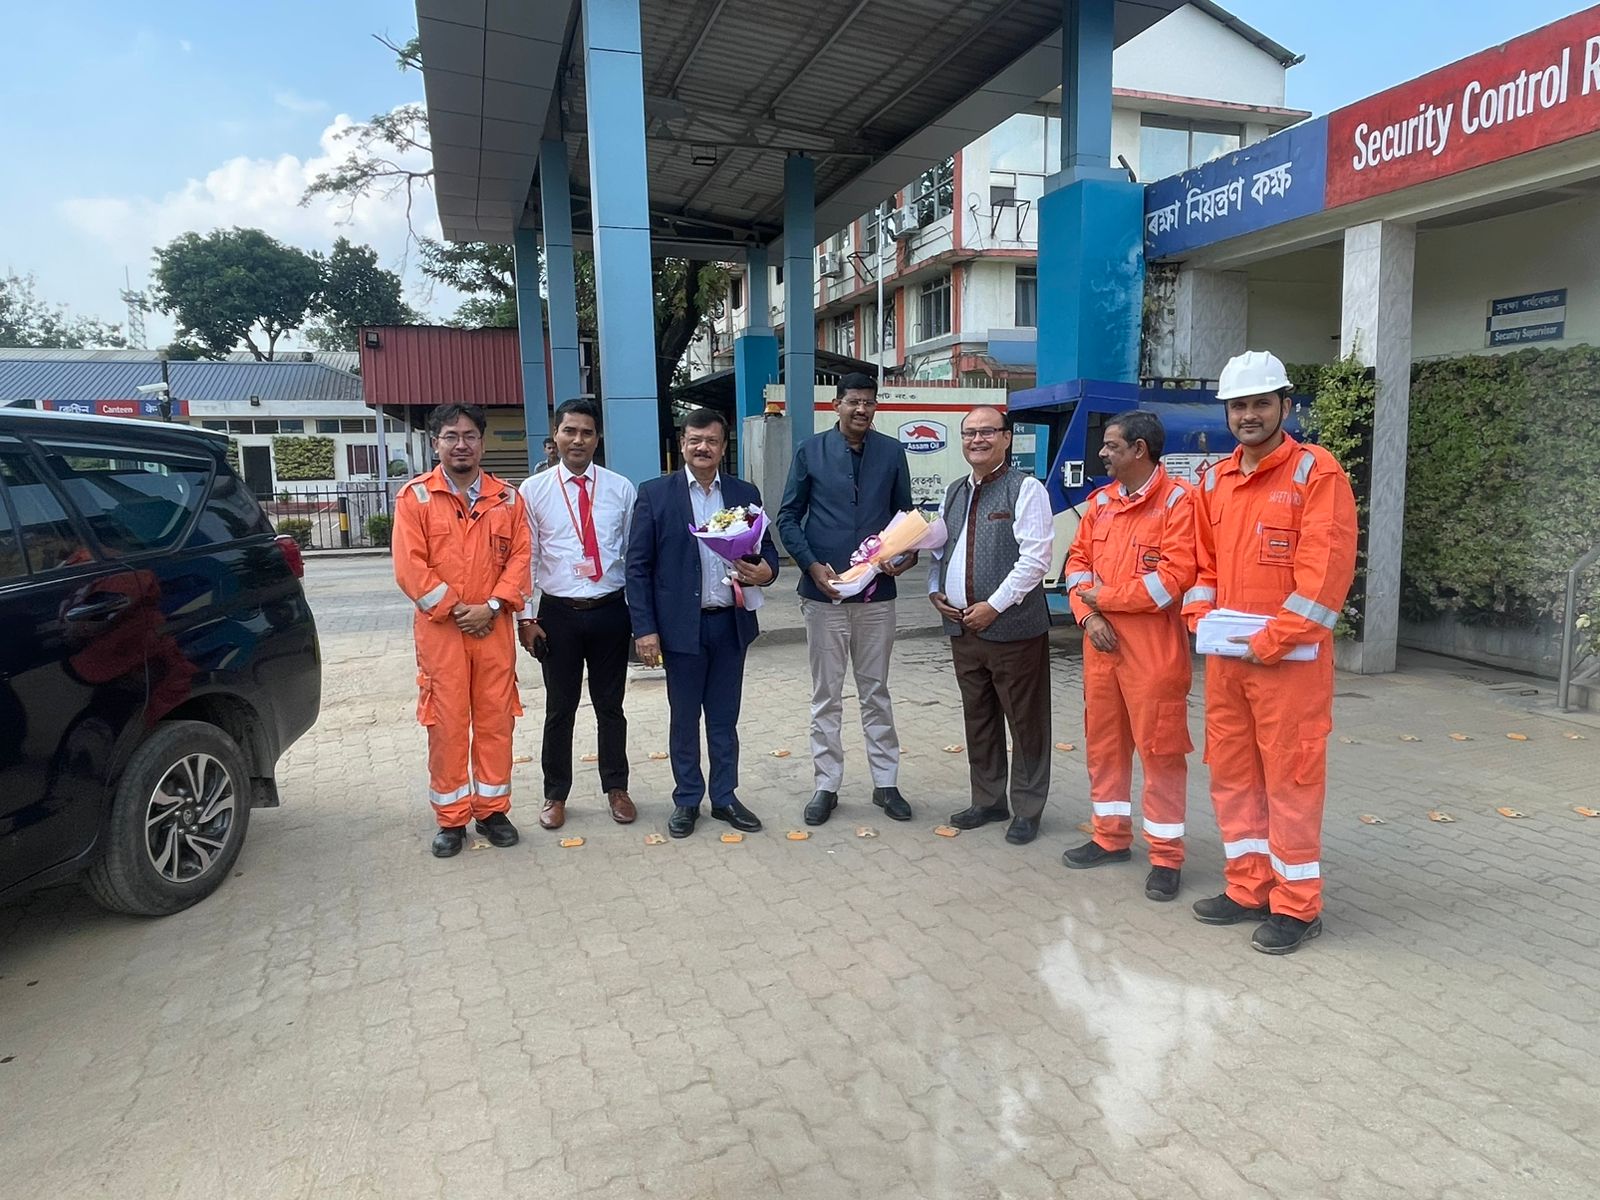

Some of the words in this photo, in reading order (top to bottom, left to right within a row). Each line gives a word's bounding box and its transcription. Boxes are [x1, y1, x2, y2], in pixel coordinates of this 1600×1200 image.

[1352, 102, 1453, 171] Security
[1461, 47, 1571, 135] Control
[1251, 161, 1293, 206] কক্ষ
[1495, 330, 1520, 342] Security
[102, 404, 134, 415] Canteen
[907, 442, 929, 450] Assam
[930, 441, 940, 450] Oil
